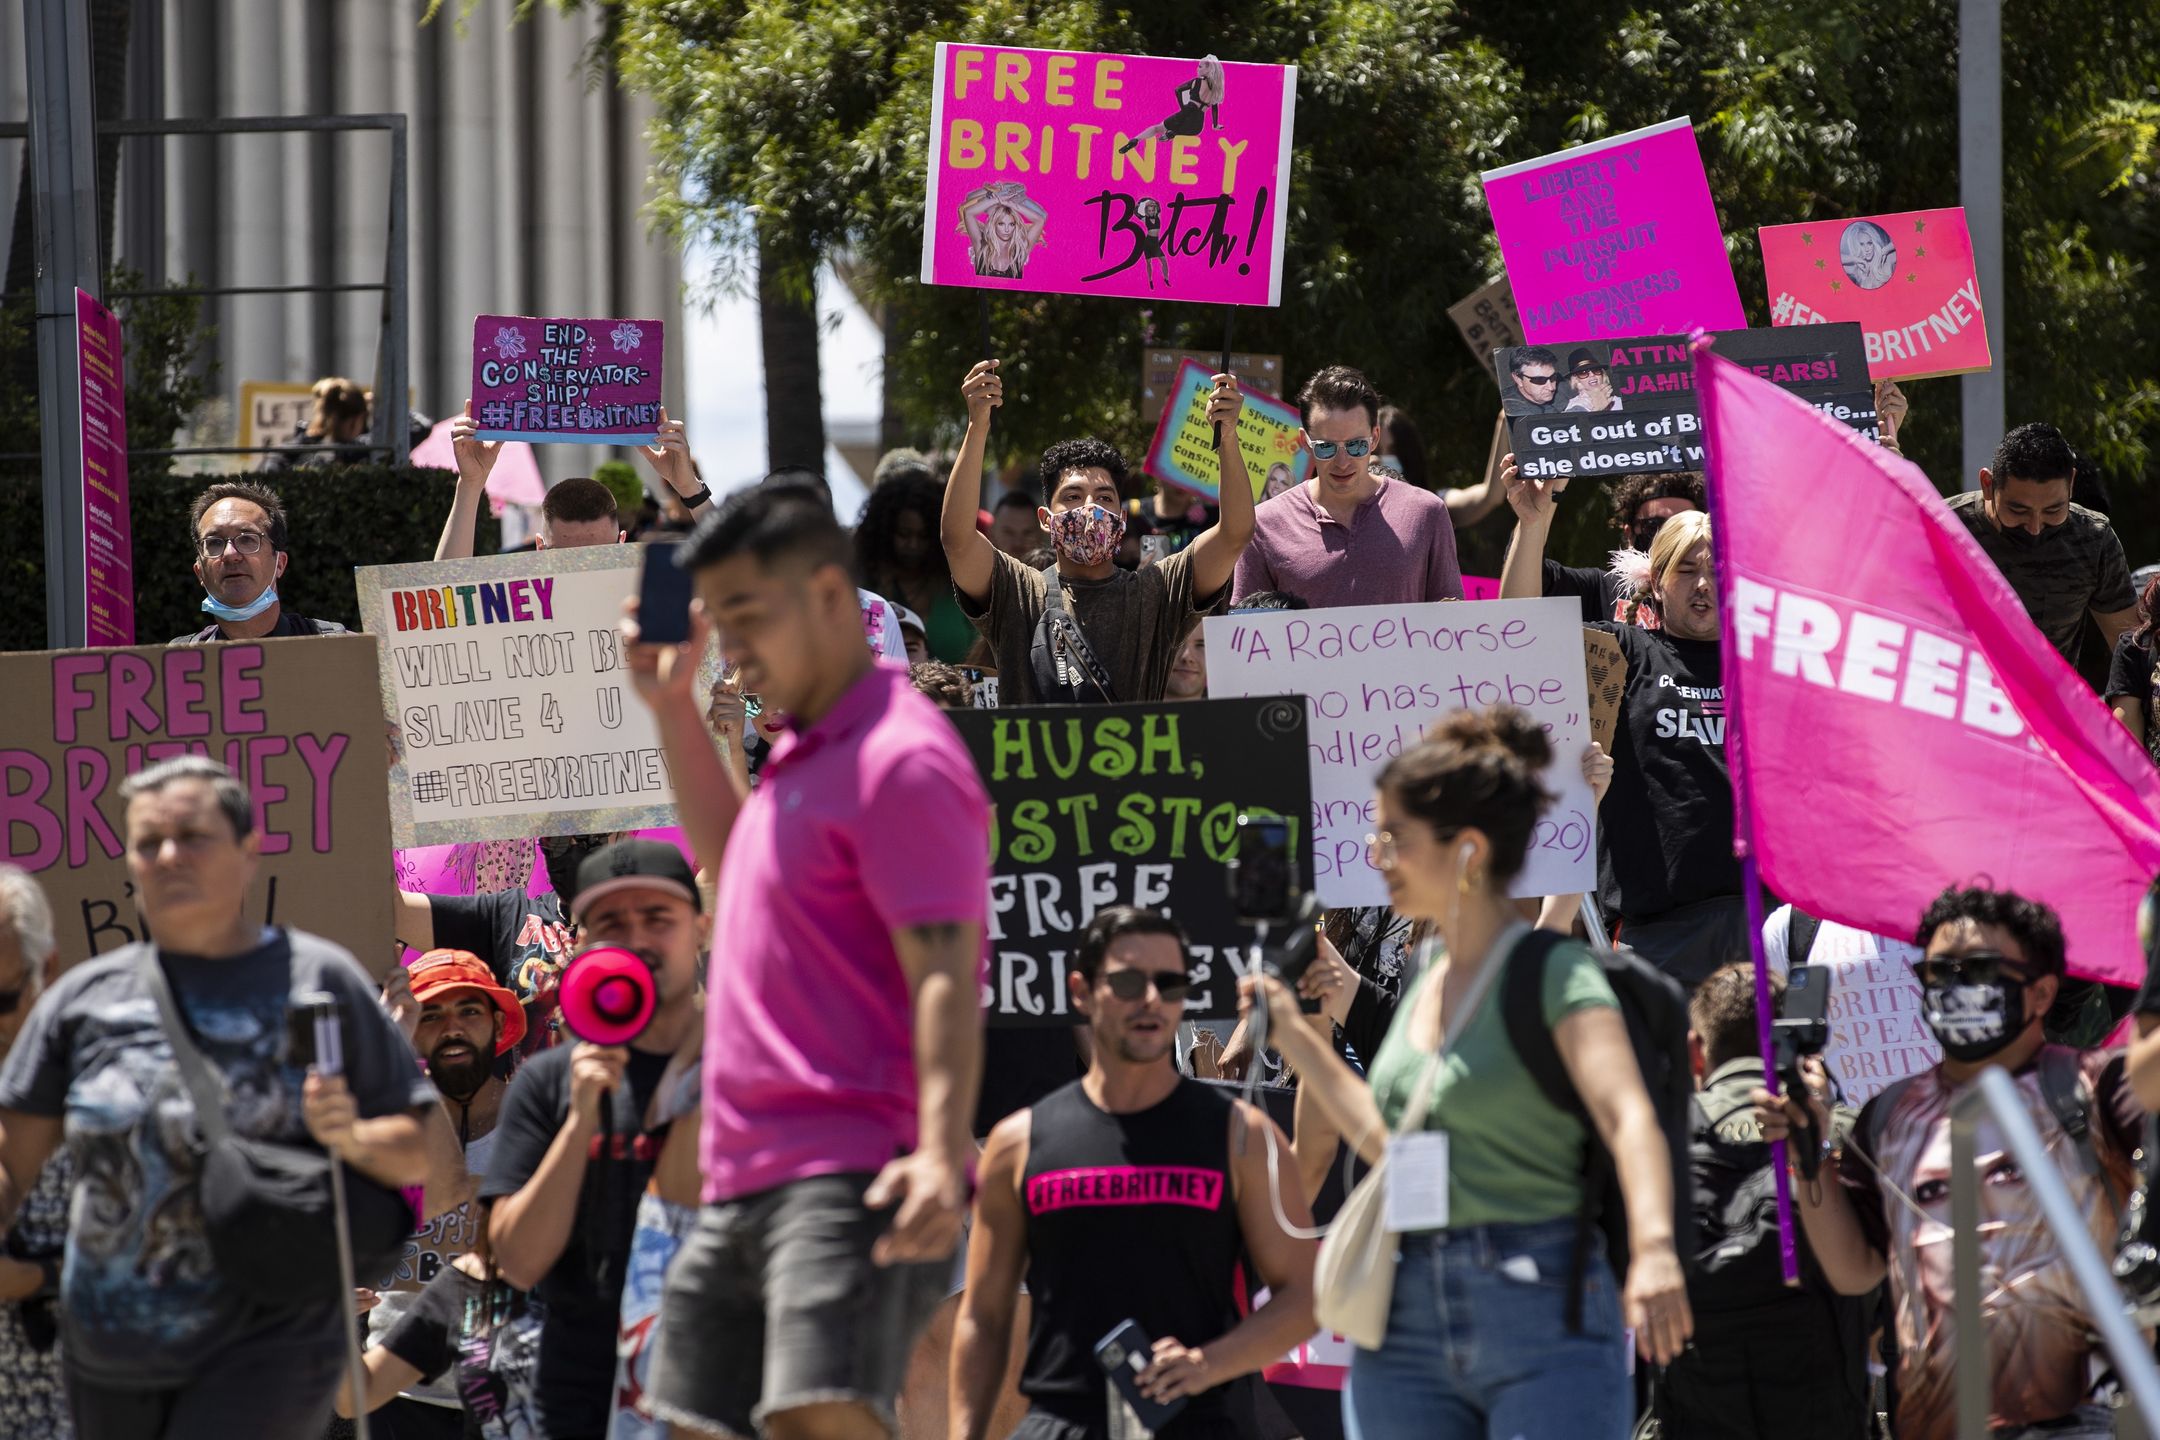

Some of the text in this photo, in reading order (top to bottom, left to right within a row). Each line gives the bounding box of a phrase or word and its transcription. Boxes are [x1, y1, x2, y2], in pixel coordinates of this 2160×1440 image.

[953, 50, 1126, 110] FREE
[948, 118, 1249, 195] BRITNEY
[1522, 149, 1642, 203] LIBERTY
[1559, 182, 1616, 219] AND
[1562, 203, 1620, 237] THE
[1080, 185, 1268, 283] Btch!
[1543, 220, 1658, 273] PURSUIT
[1526, 268, 1682, 331] HAPPINESS
[1771, 278, 1982, 364] #FBRITNEY
[544, 323, 588, 345] END
[1611, 343, 1689, 367] ATTN
[540, 347, 583, 367] THE
[1746, 359, 1838, 383] EARS!
[481, 400, 662, 430] #FREEBRITNEY
[1185, 413, 1209, 430] due
[1248, 406, 1290, 433] spears
[1531, 424, 1583, 446] Get
[1591, 419, 1638, 440] out
[1644, 416, 1672, 436] of
[1247, 460, 1266, 477] the
[1523, 457, 1573, 477] she
[392, 577, 554, 632] BRITNEY
[394, 640, 491, 688] WILL
[503, 631, 574, 678] NOT
[1286, 616, 1537, 662] Racehorse
[1733, 575, 2044, 752] FREEB
[52, 644, 266, 743] FREE
[1363, 682, 1440, 712] has
[404, 687, 622, 748] SLAVE 4 U
[1656, 708, 1727, 745] SLAV
[992, 714, 1204, 780] HUSH,
[1307, 724, 1404, 768] ndled
[0, 732, 350, 874] BREY
[986, 862, 1174, 941] FREE
[1832, 1015, 1930, 1050] SPEA
[1839, 1045, 1940, 1081] BRITN
